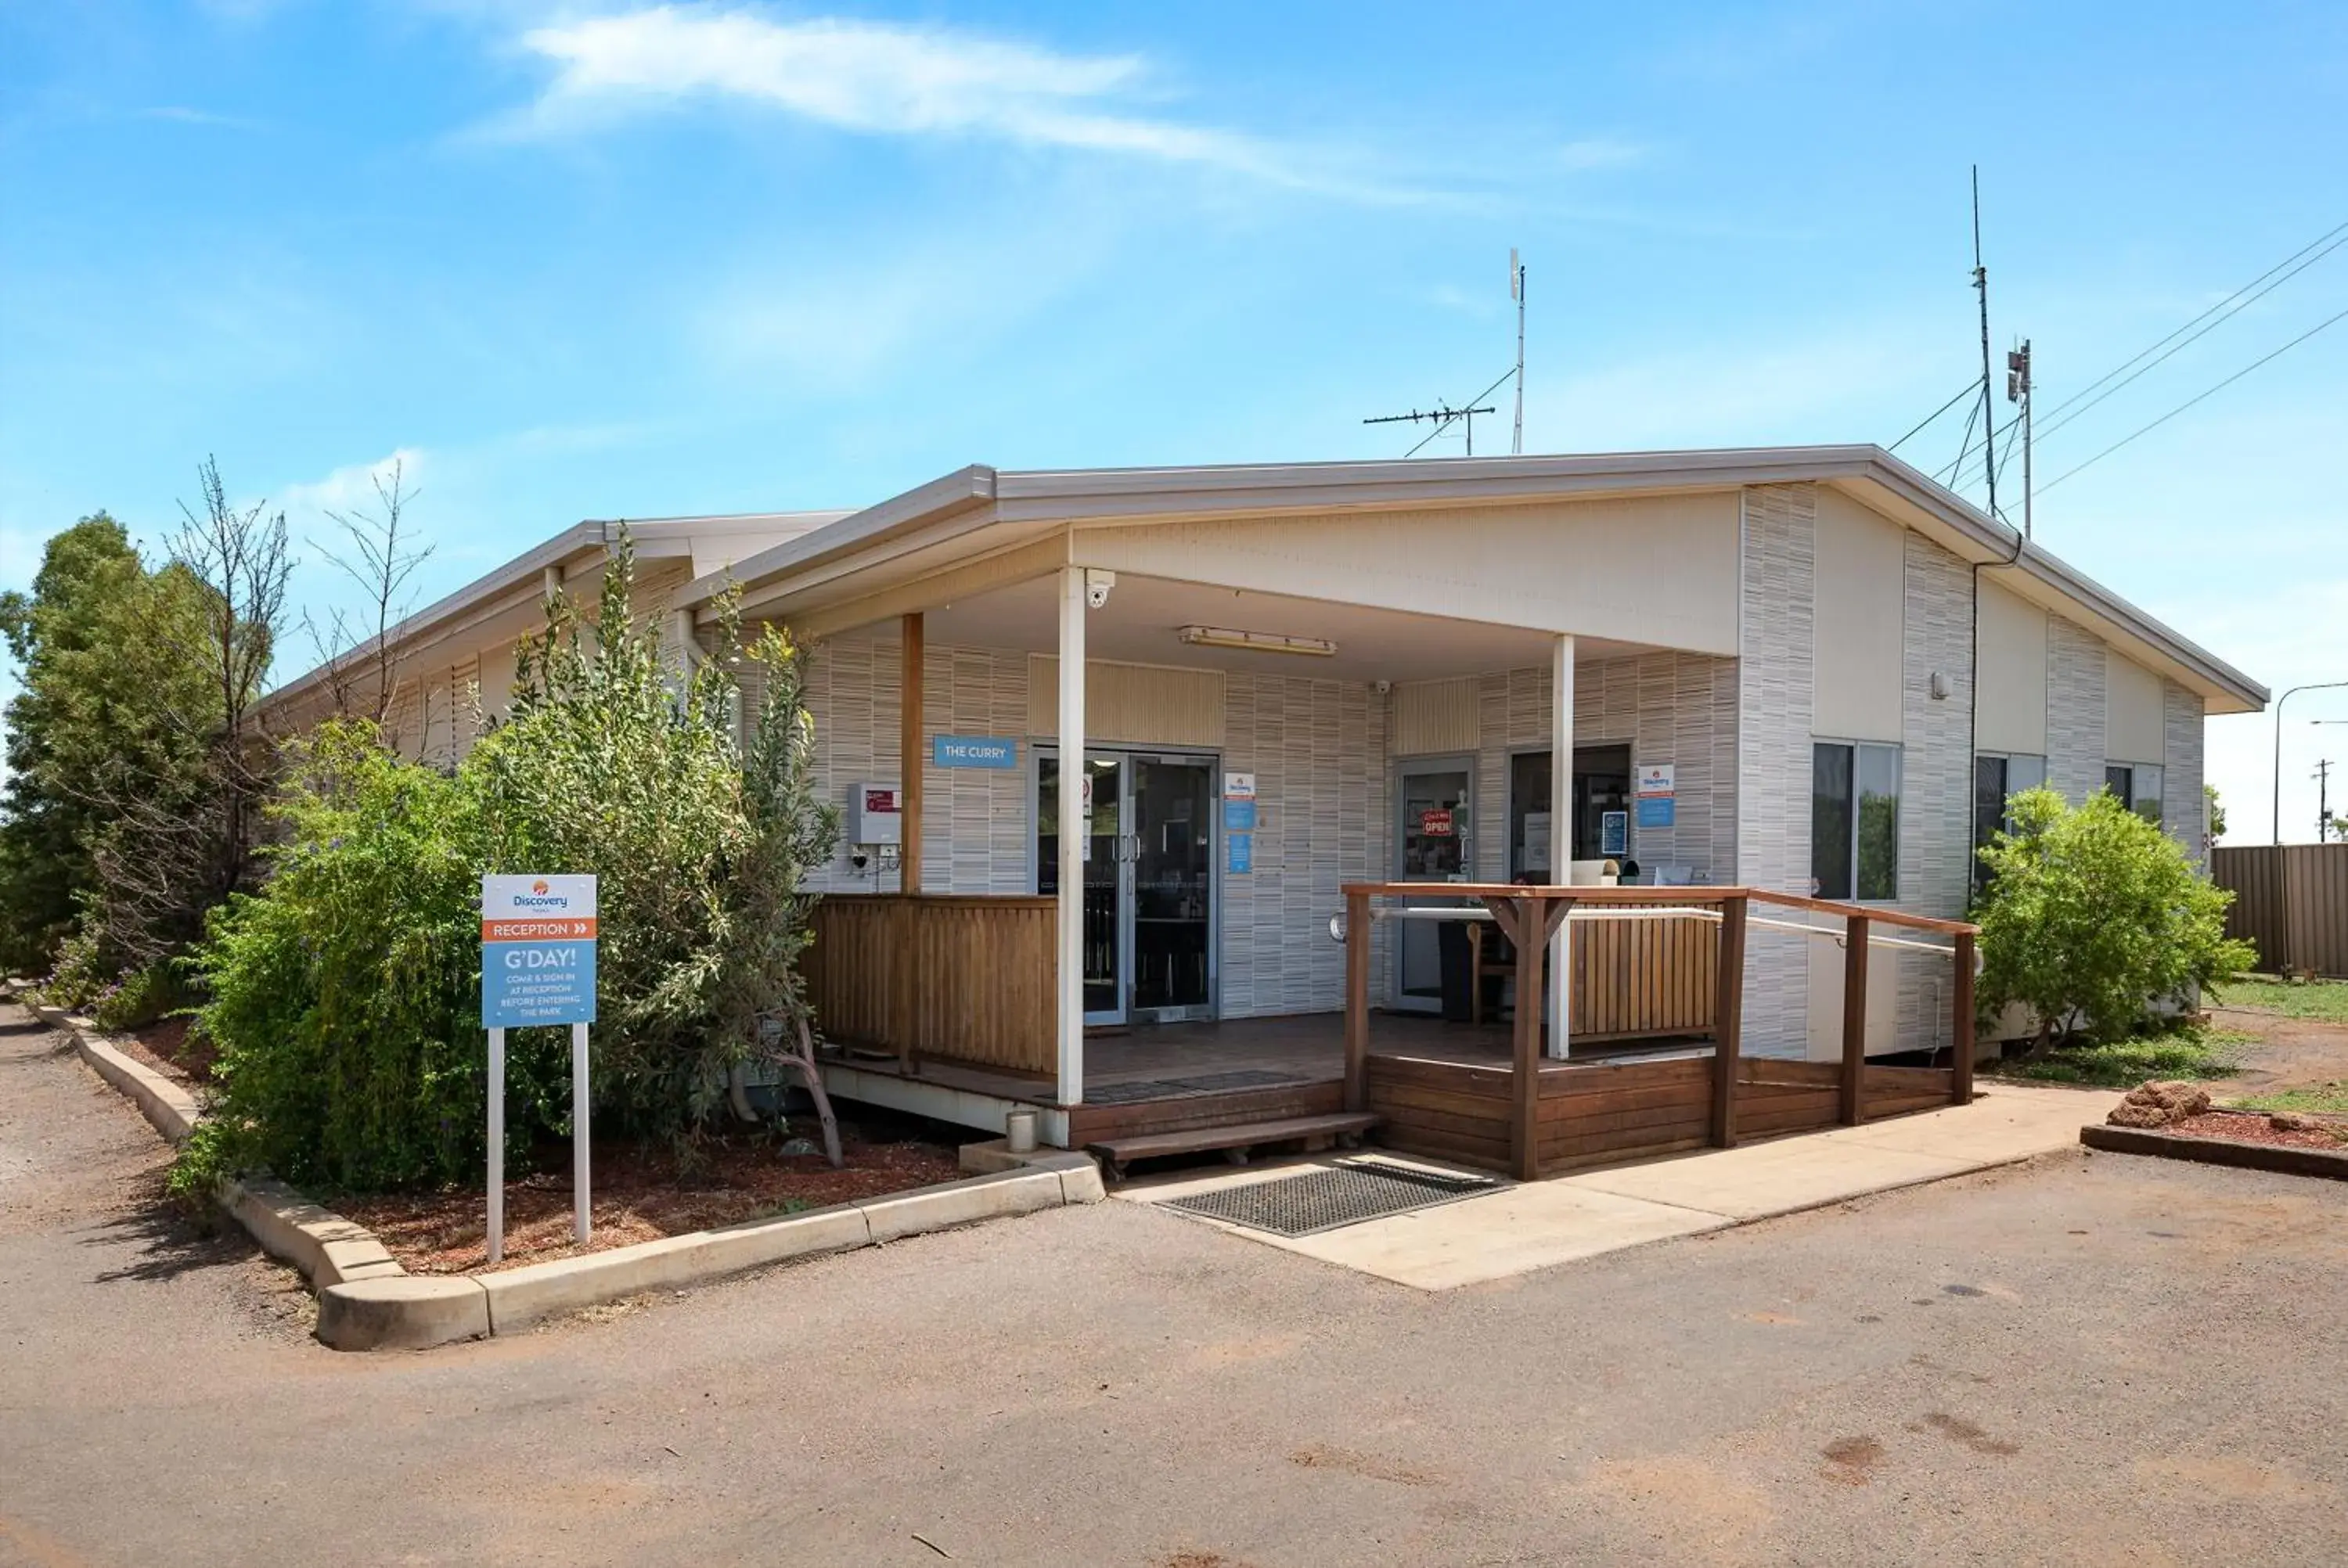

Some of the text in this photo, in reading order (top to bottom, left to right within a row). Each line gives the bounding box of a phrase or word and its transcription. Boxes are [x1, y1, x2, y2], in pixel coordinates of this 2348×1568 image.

[945, 746, 1007, 759] THE CURRY
[513, 896, 567, 908] Discovery
[494, 923, 567, 937] RECEPTION
[505, 948, 576, 969] G'DAY!
[506, 974, 533, 984] COME
[543, 973, 564, 982] SIGN
[523, 985, 571, 994] RECEPTION
[500, 995, 581, 1008] BEFORE ENTERING
[539, 1007, 562, 1016] PARK
